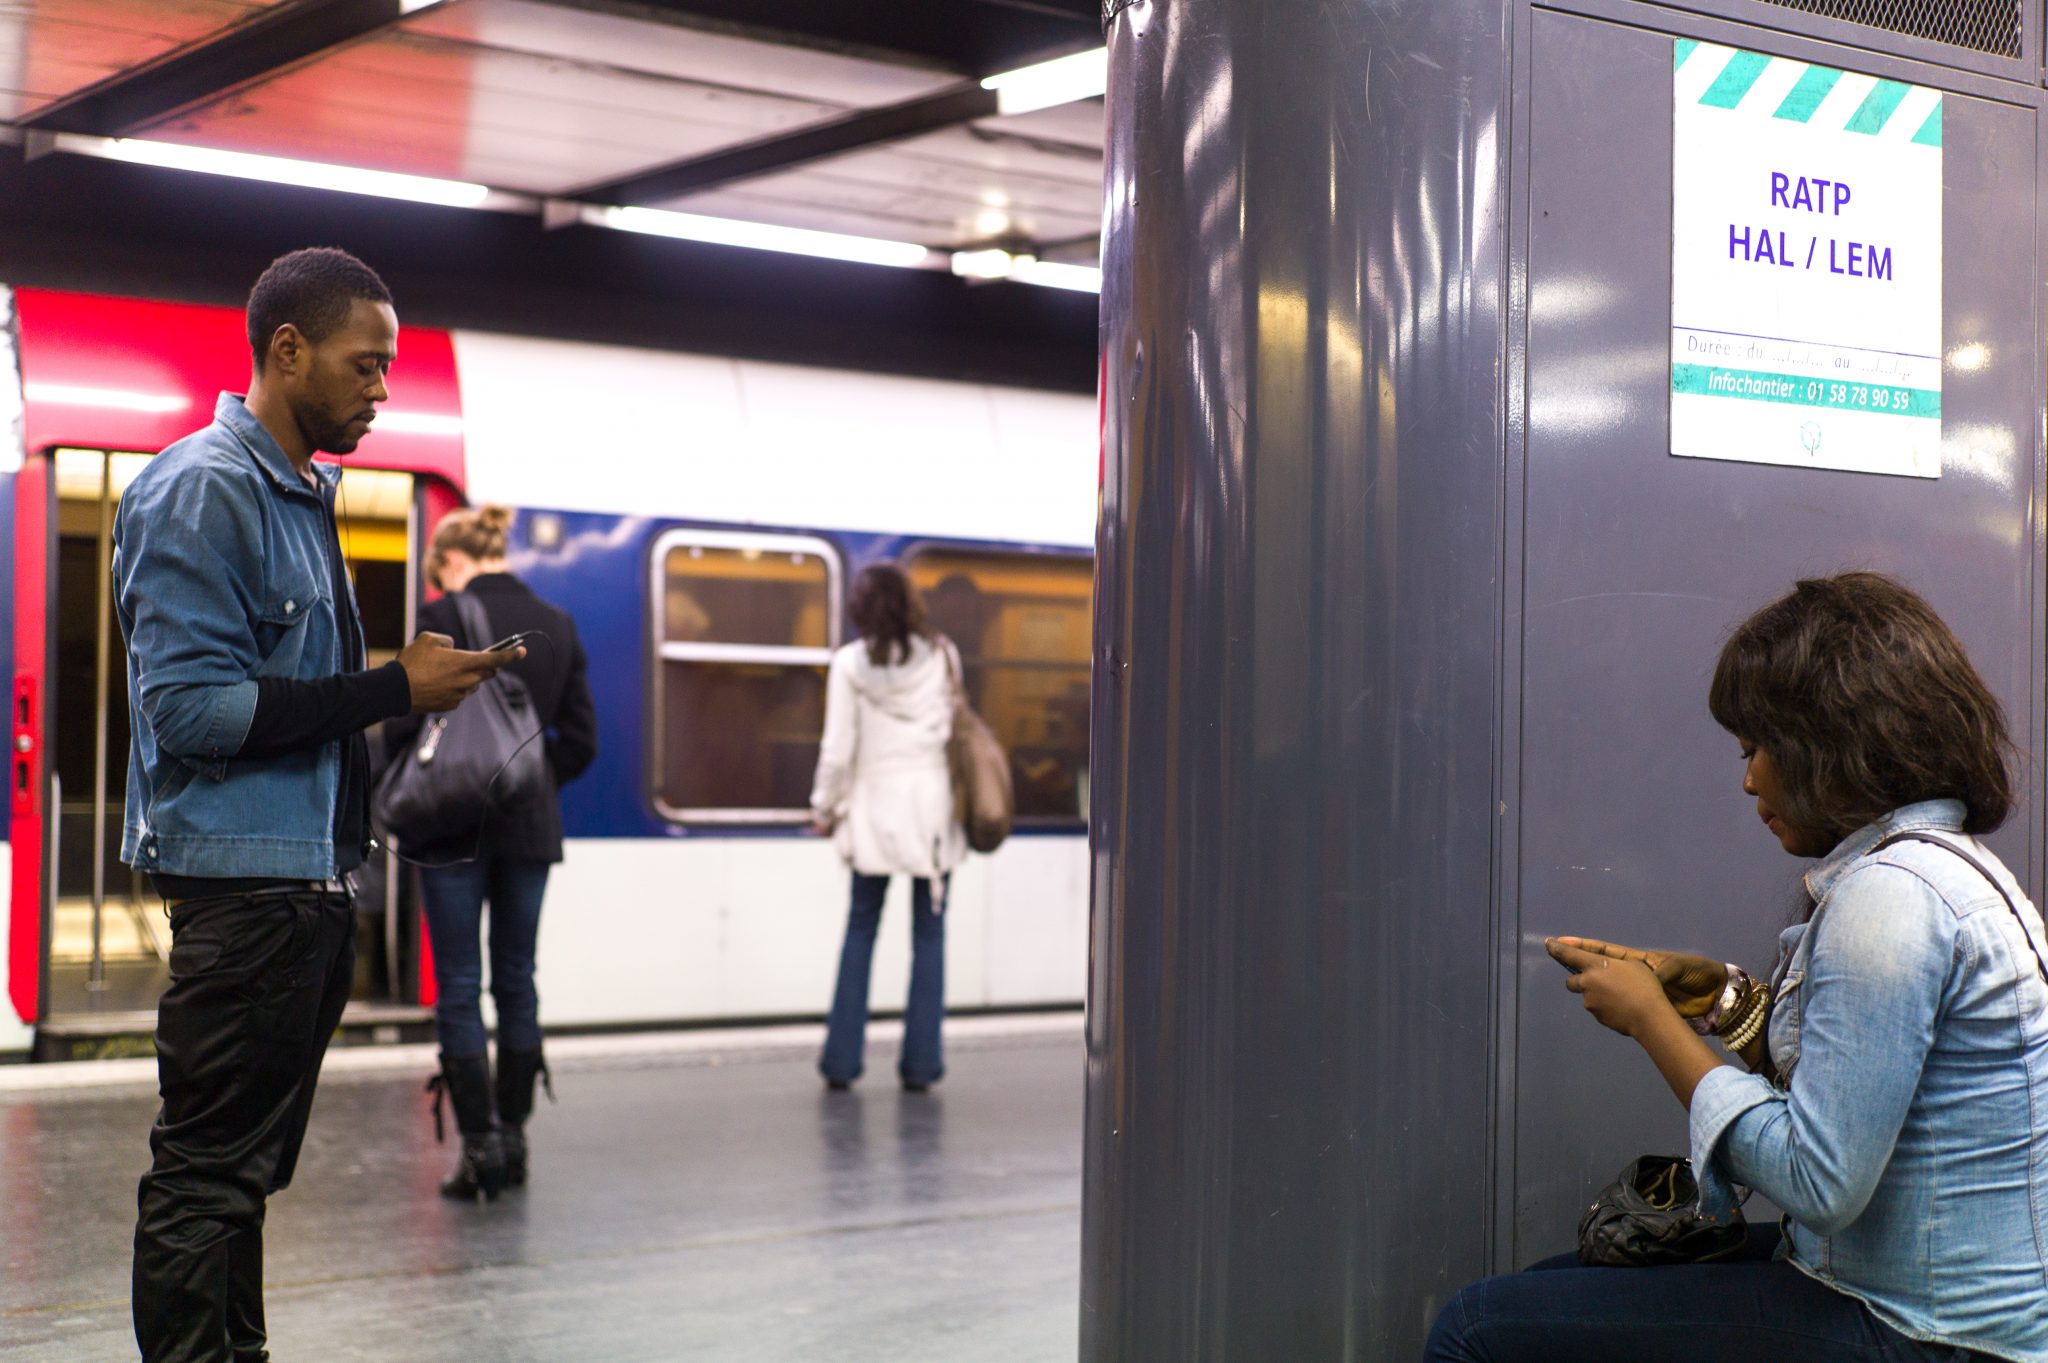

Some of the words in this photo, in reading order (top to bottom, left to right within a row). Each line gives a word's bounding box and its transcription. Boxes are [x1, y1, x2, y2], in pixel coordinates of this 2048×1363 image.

[1771, 171, 1851, 216] RATP
[1729, 223, 1795, 268] HAL
[1805, 236, 1817, 270] /
[1829, 238, 1893, 281] LEM
[1688, 335, 1731, 355] Durée
[1747, 343, 1763, 359] du
[1834, 357, 1850, 370] au
[1708, 371, 1795, 397] Infochantier
[1807, 380, 1824, 401] 01
[1829, 383, 1847, 404] 58
[1851, 385, 1868, 406] 78
[1872, 388, 1889, 408] 90
[1892, 390, 1909, 410] 59
